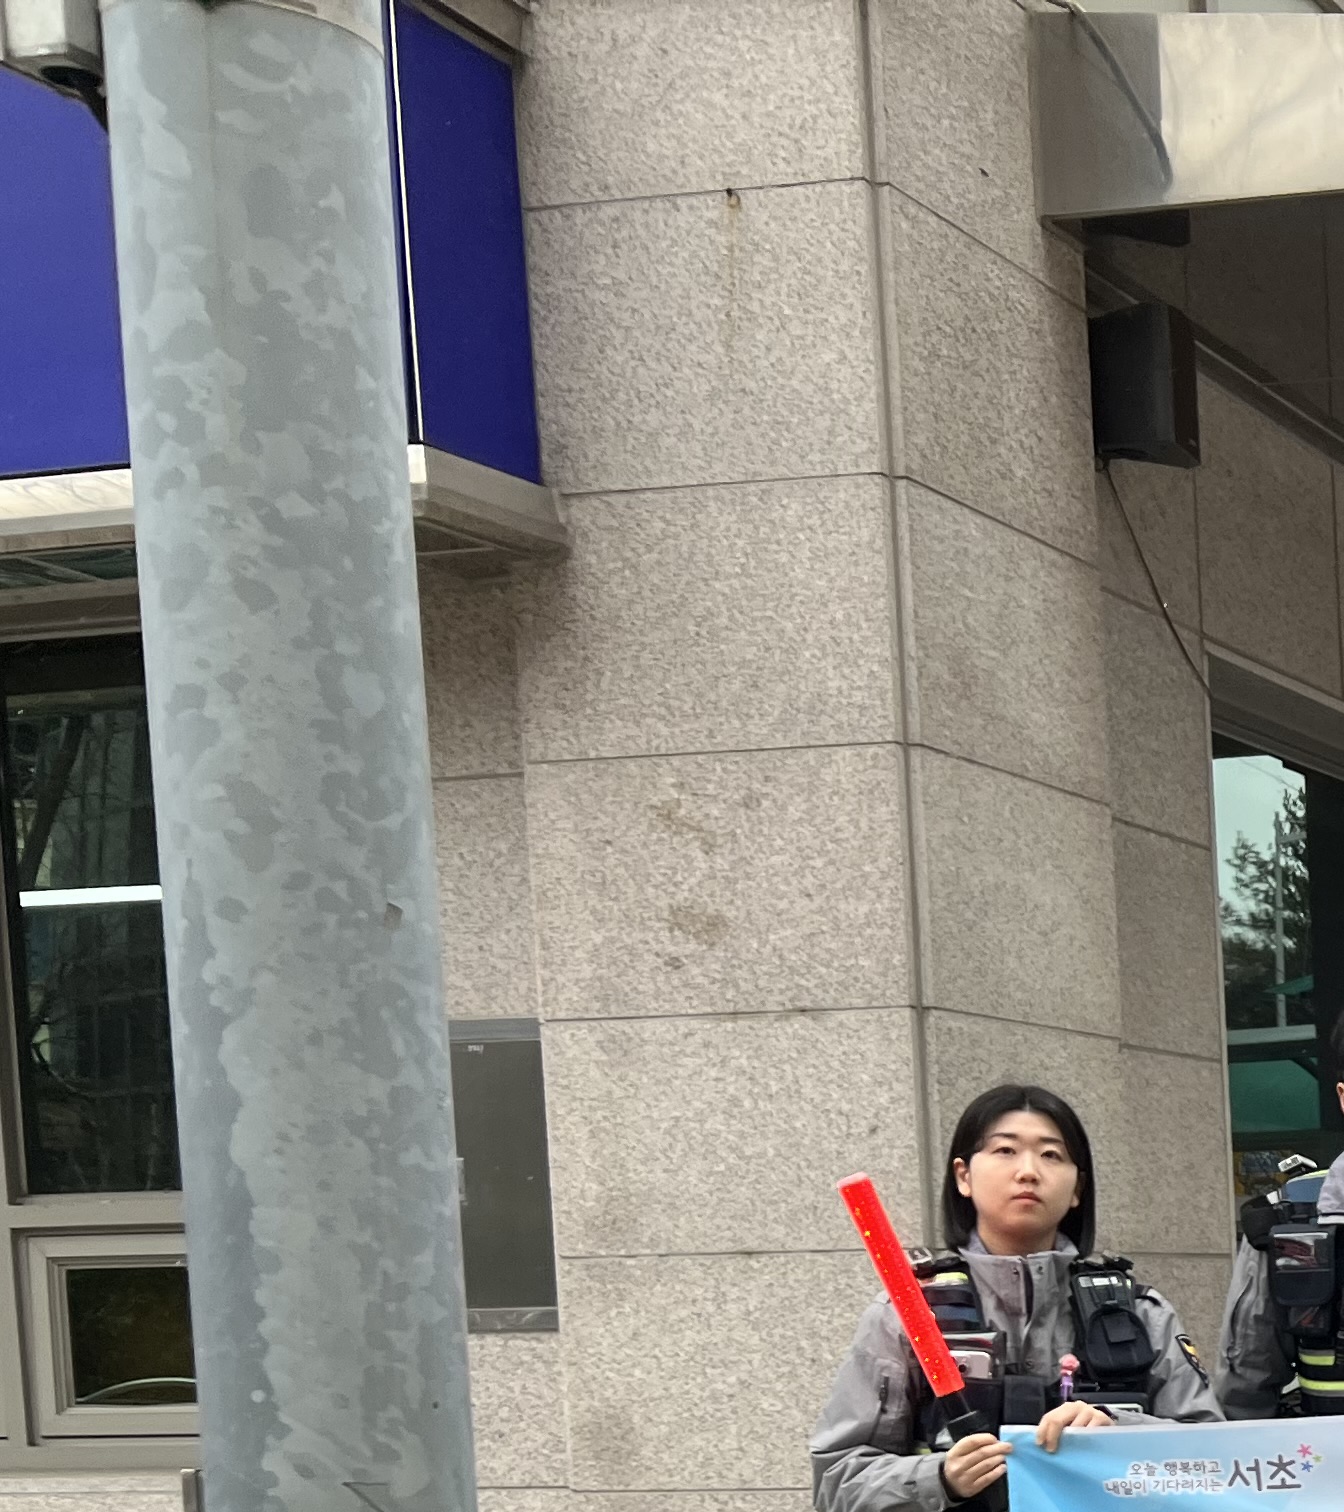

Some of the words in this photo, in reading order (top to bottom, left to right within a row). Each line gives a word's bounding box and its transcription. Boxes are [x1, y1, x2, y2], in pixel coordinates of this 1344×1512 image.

[1129, 1462, 1158, 1476] 오늘
[1164, 1460, 1222, 1476] 행복하고
[1228, 1454, 1302, 1492] 서초
[1104, 1479, 1148, 1496] 내일이
[1153, 1478, 1224, 1493] 기다려지는
